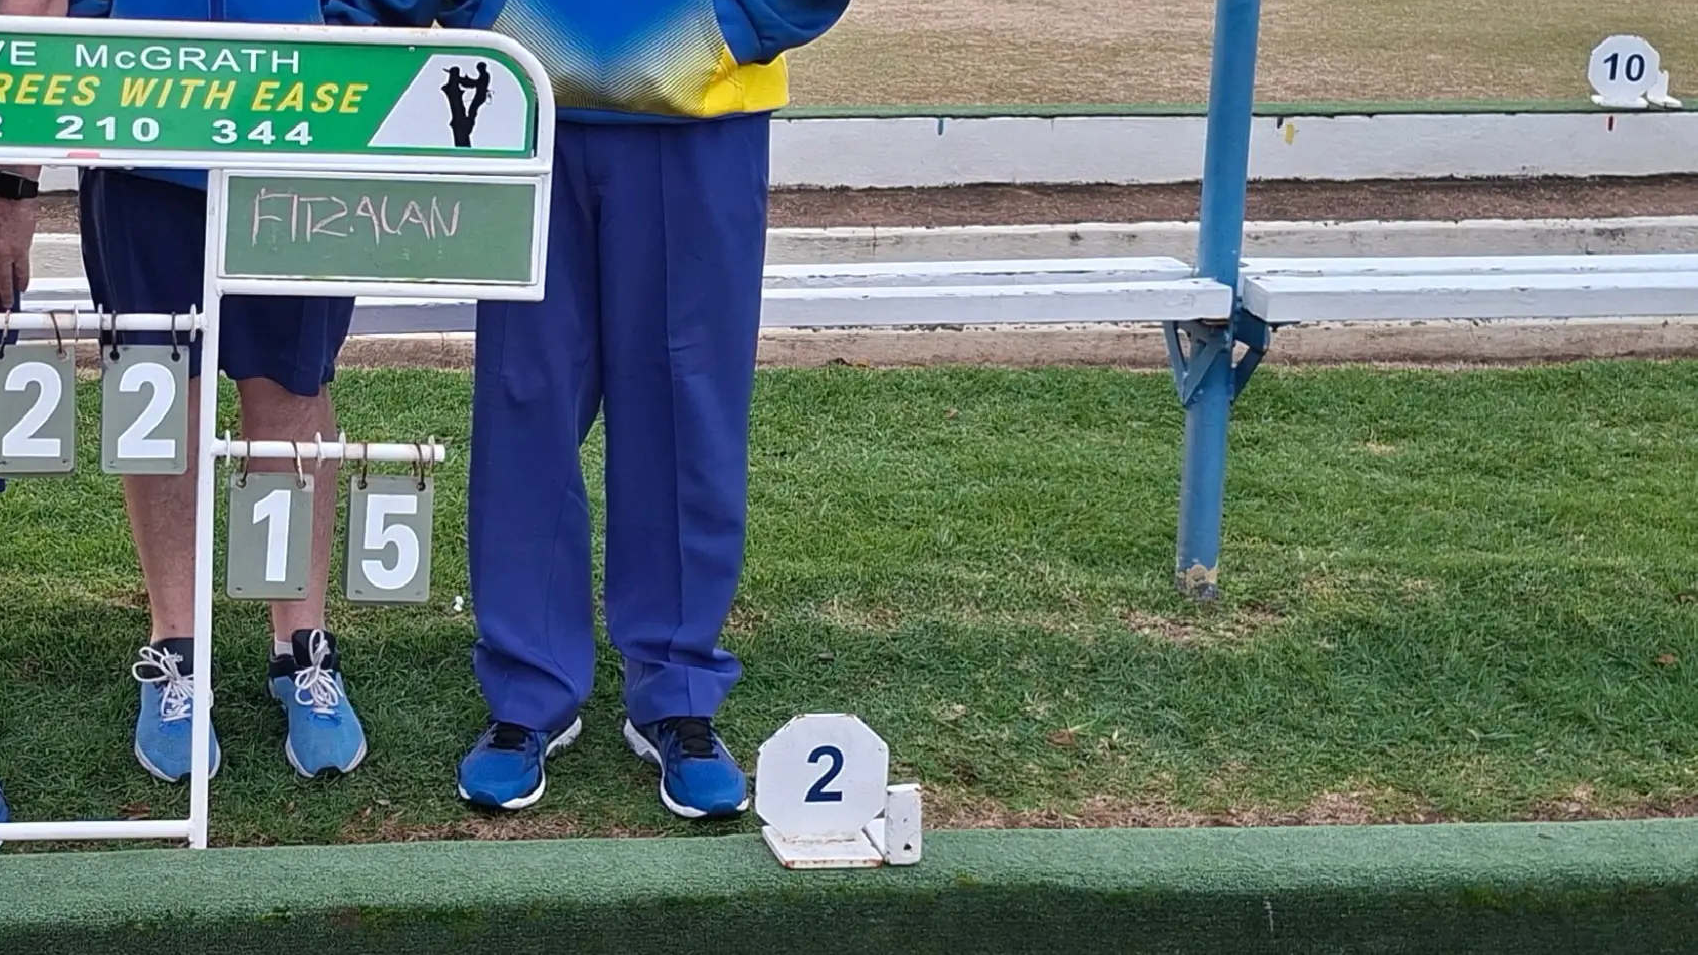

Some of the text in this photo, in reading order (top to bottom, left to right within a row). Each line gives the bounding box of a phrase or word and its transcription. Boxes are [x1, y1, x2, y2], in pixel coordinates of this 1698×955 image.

[75, 44, 300, 74] McGRATH
[1603, 52, 1645, 82] 10
[120, 78, 237, 111] WITH
[251, 81, 369, 114] EASE
[55, 115, 160, 141] 210
[211, 119, 313, 145] 344
[803, 744, 845, 803] 2
